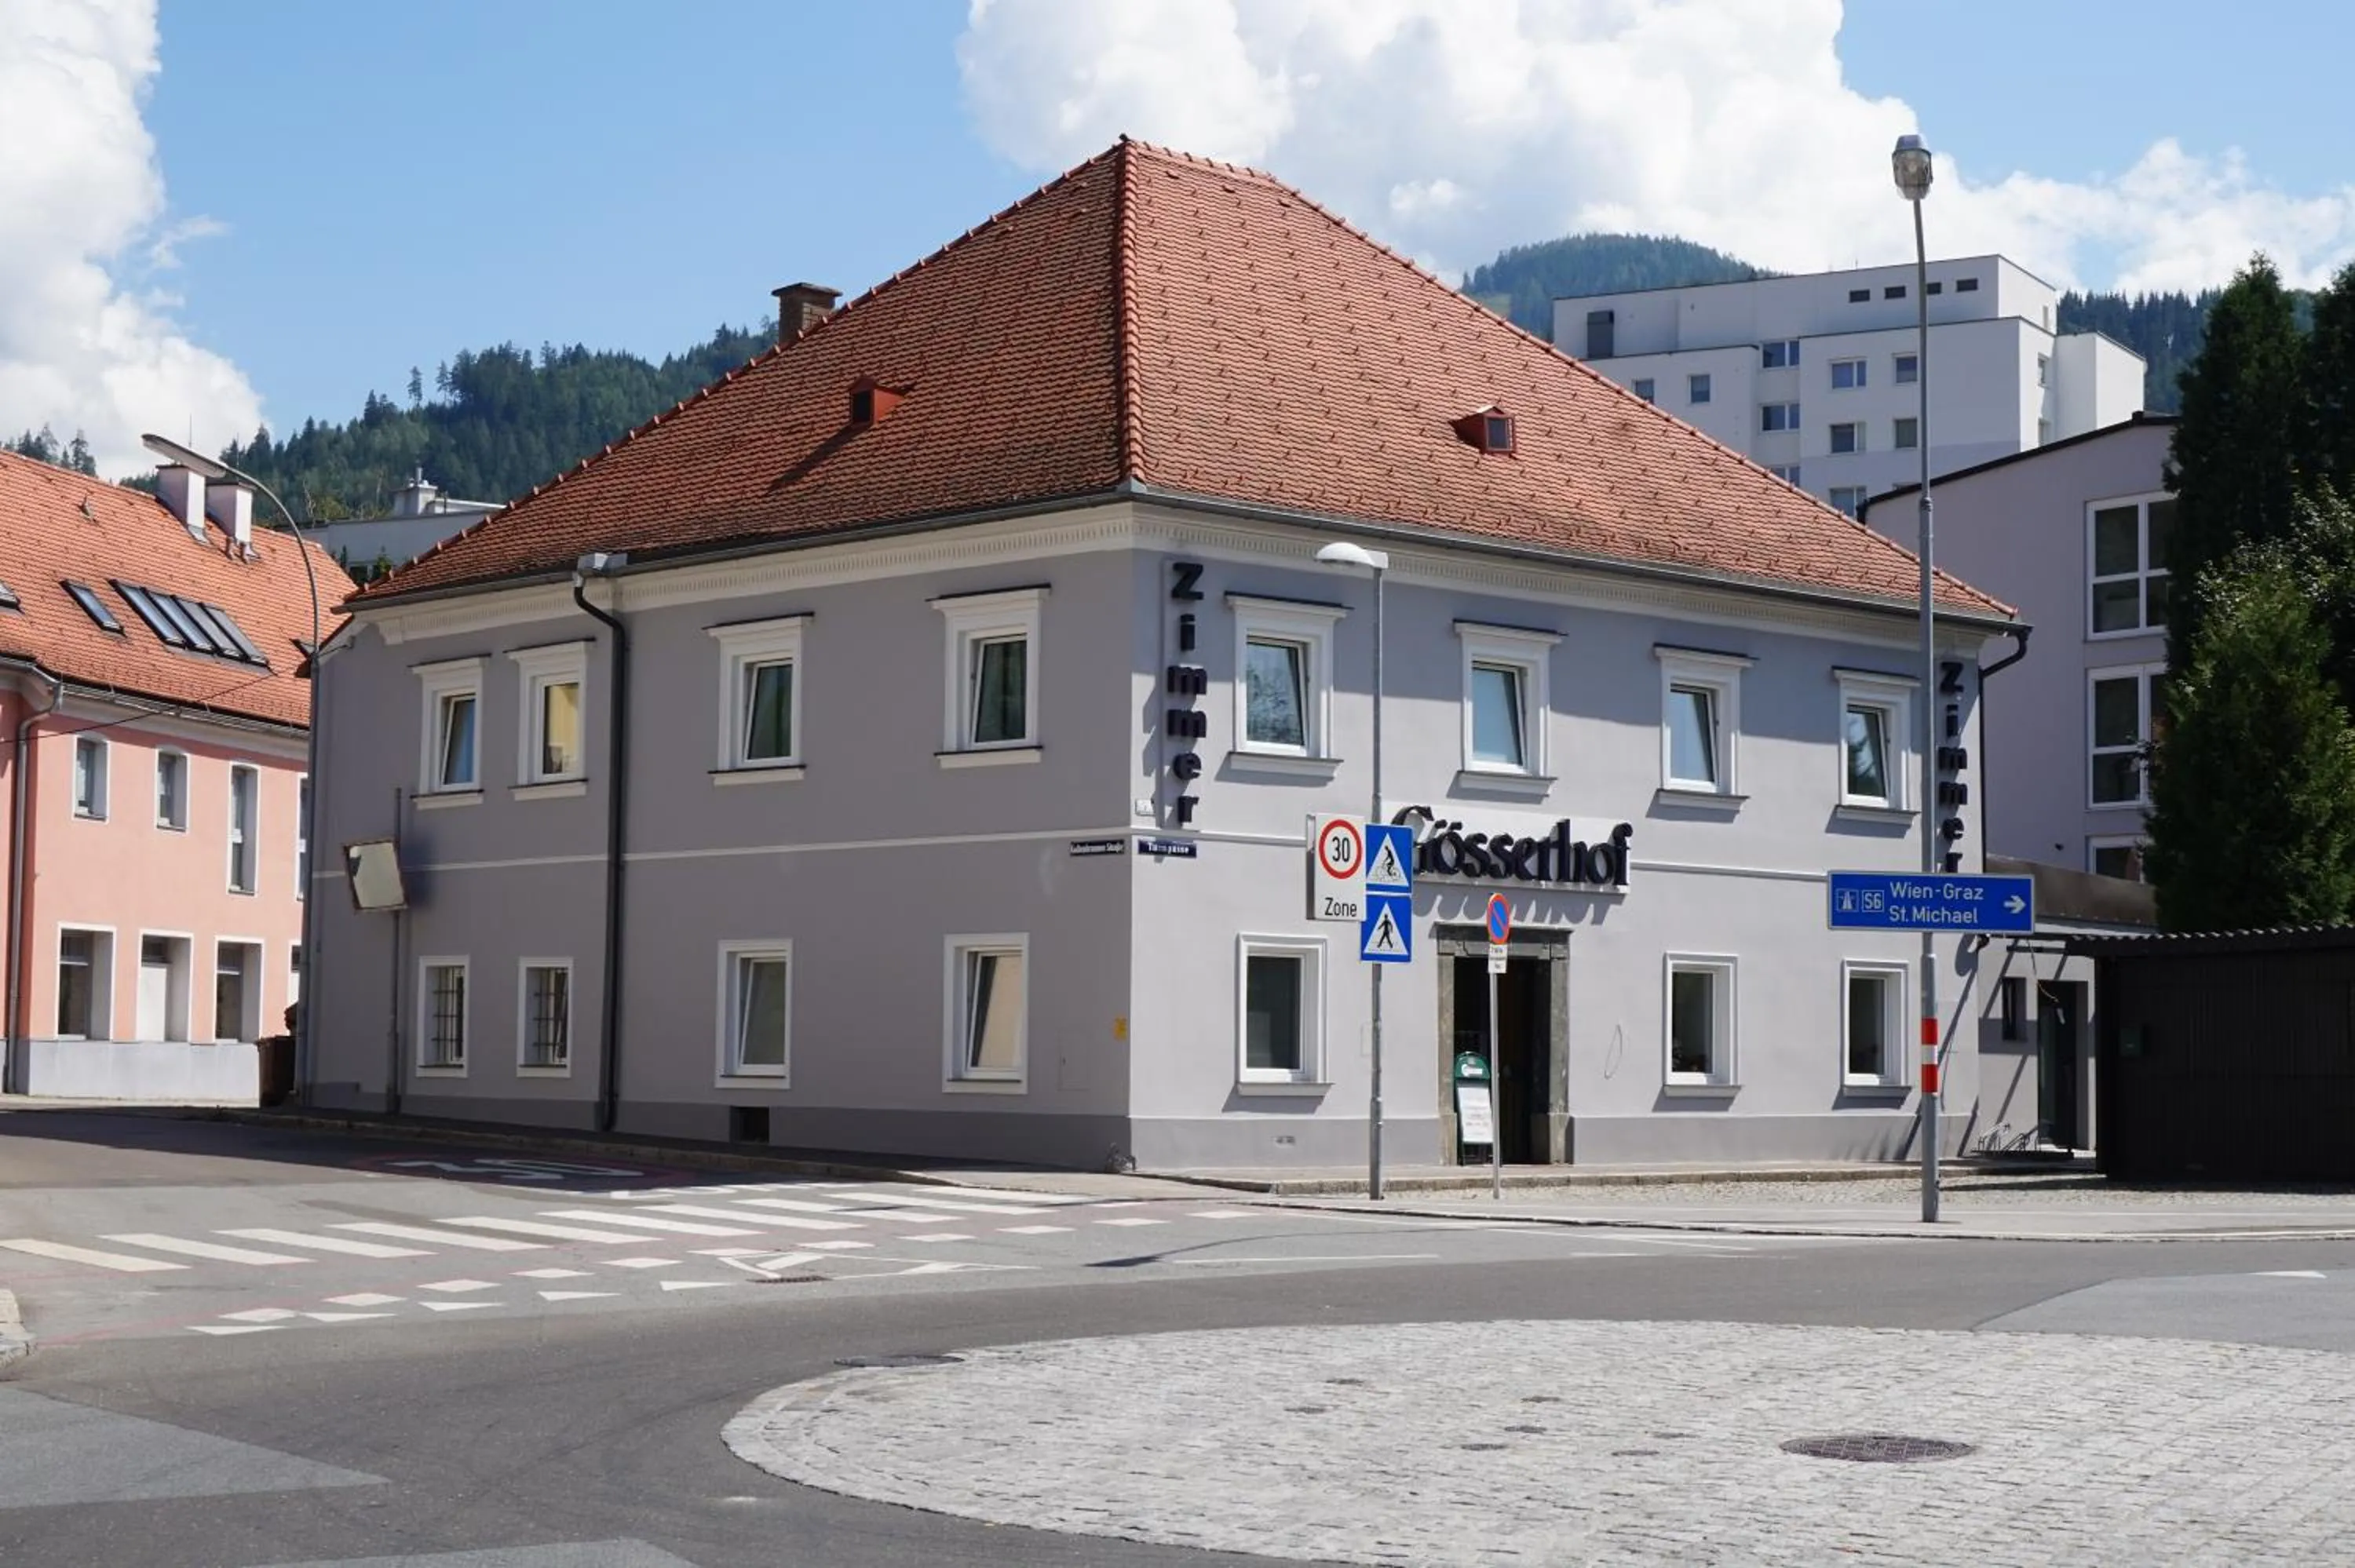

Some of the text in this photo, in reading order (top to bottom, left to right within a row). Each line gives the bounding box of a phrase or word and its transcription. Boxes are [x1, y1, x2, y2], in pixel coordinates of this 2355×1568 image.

[1167, 562, 1207, 823] Zimmer
[1938, 662, 1968, 873] Zimmer
[1331, 836, 1350, 862] 30
[1864, 891, 1882, 910] S6
[1889, 881, 1984, 901] Wien-Graz
[1324, 897, 1357, 917] Zone
[1889, 905, 1978, 924] St. Michael
